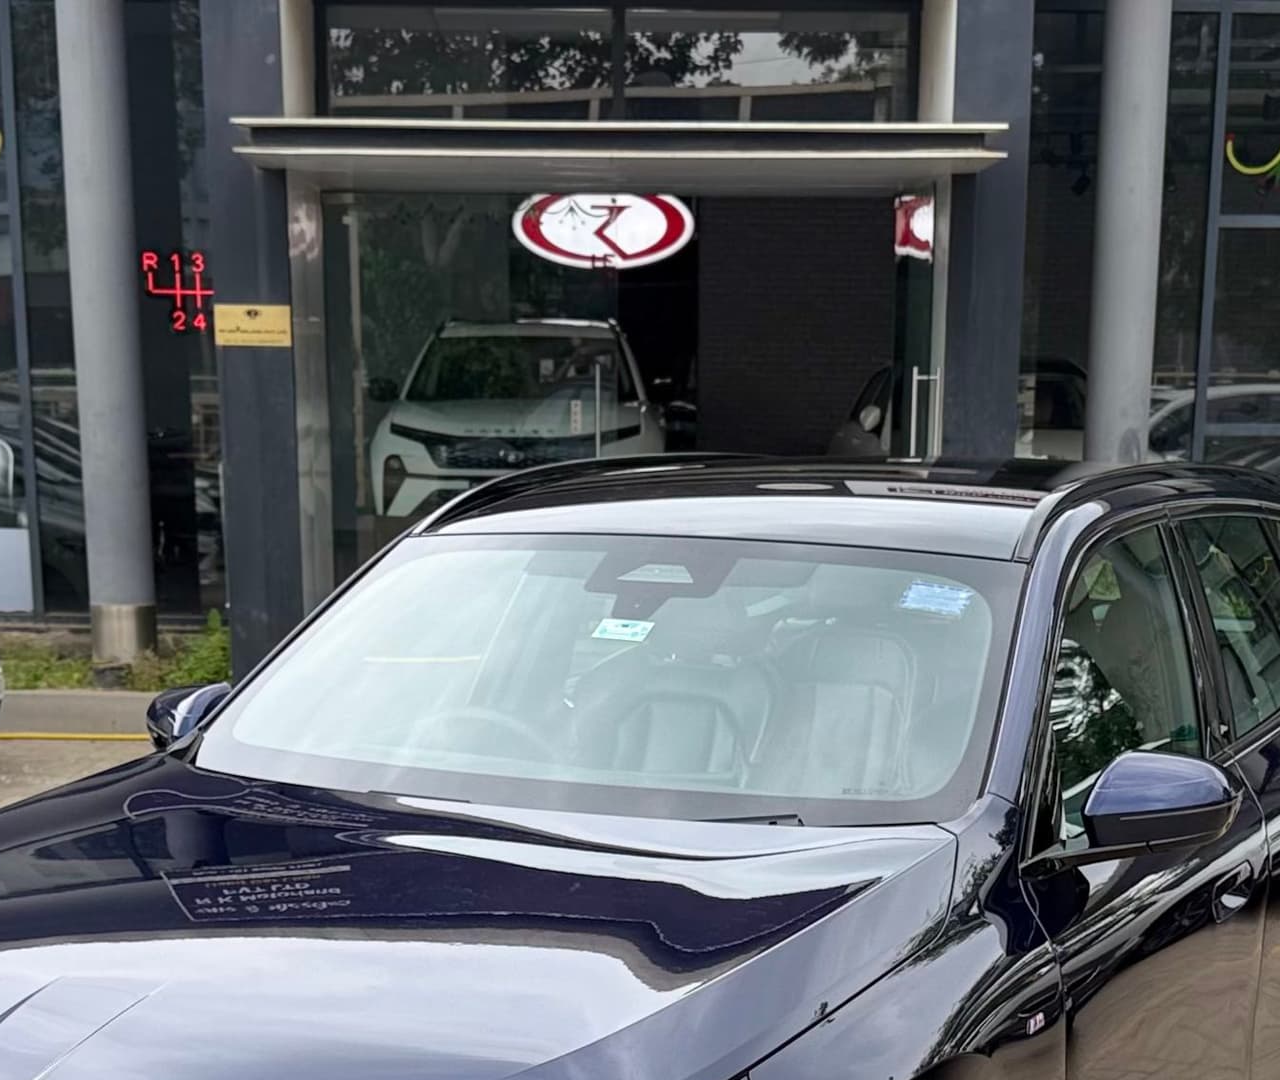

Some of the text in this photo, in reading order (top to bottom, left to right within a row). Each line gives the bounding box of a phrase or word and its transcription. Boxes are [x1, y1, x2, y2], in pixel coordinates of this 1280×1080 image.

[143, 252, 204, 272] R 1 3
[173, 311, 186, 330] 2
[194, 314, 206, 331] 4
